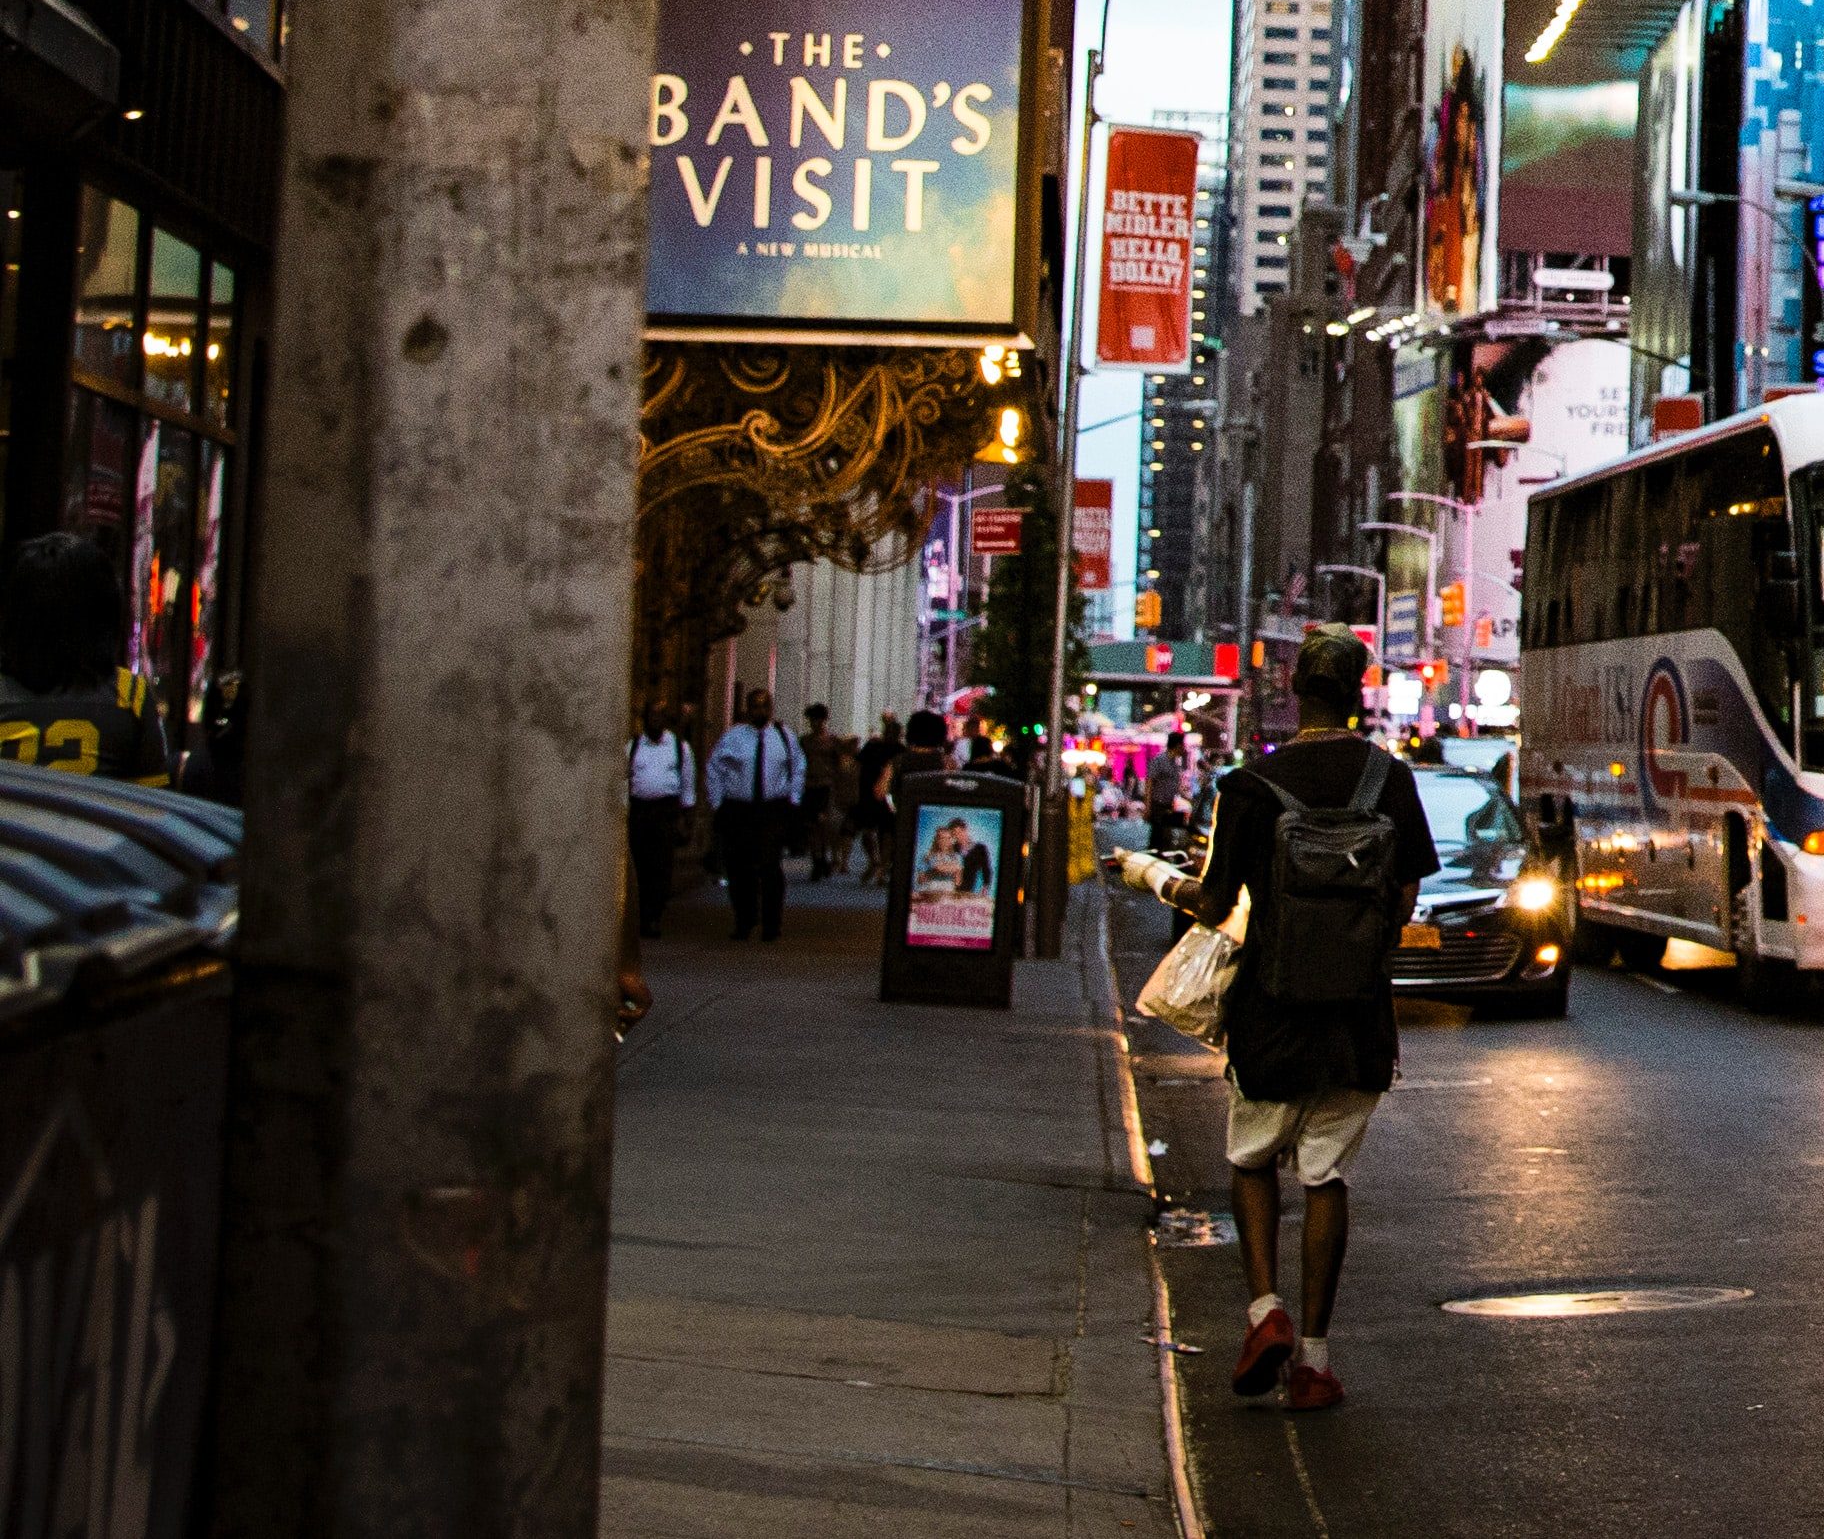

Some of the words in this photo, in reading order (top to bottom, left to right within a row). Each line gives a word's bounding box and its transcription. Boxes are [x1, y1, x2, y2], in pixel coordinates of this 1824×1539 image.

[769, 32, 864, 69] THE
[649, 73, 993, 156] BAND'S
[676, 156, 941, 233] VISIT
[756, 242, 796, 259] NEW
[802, 242, 883, 260] MUSICAL
